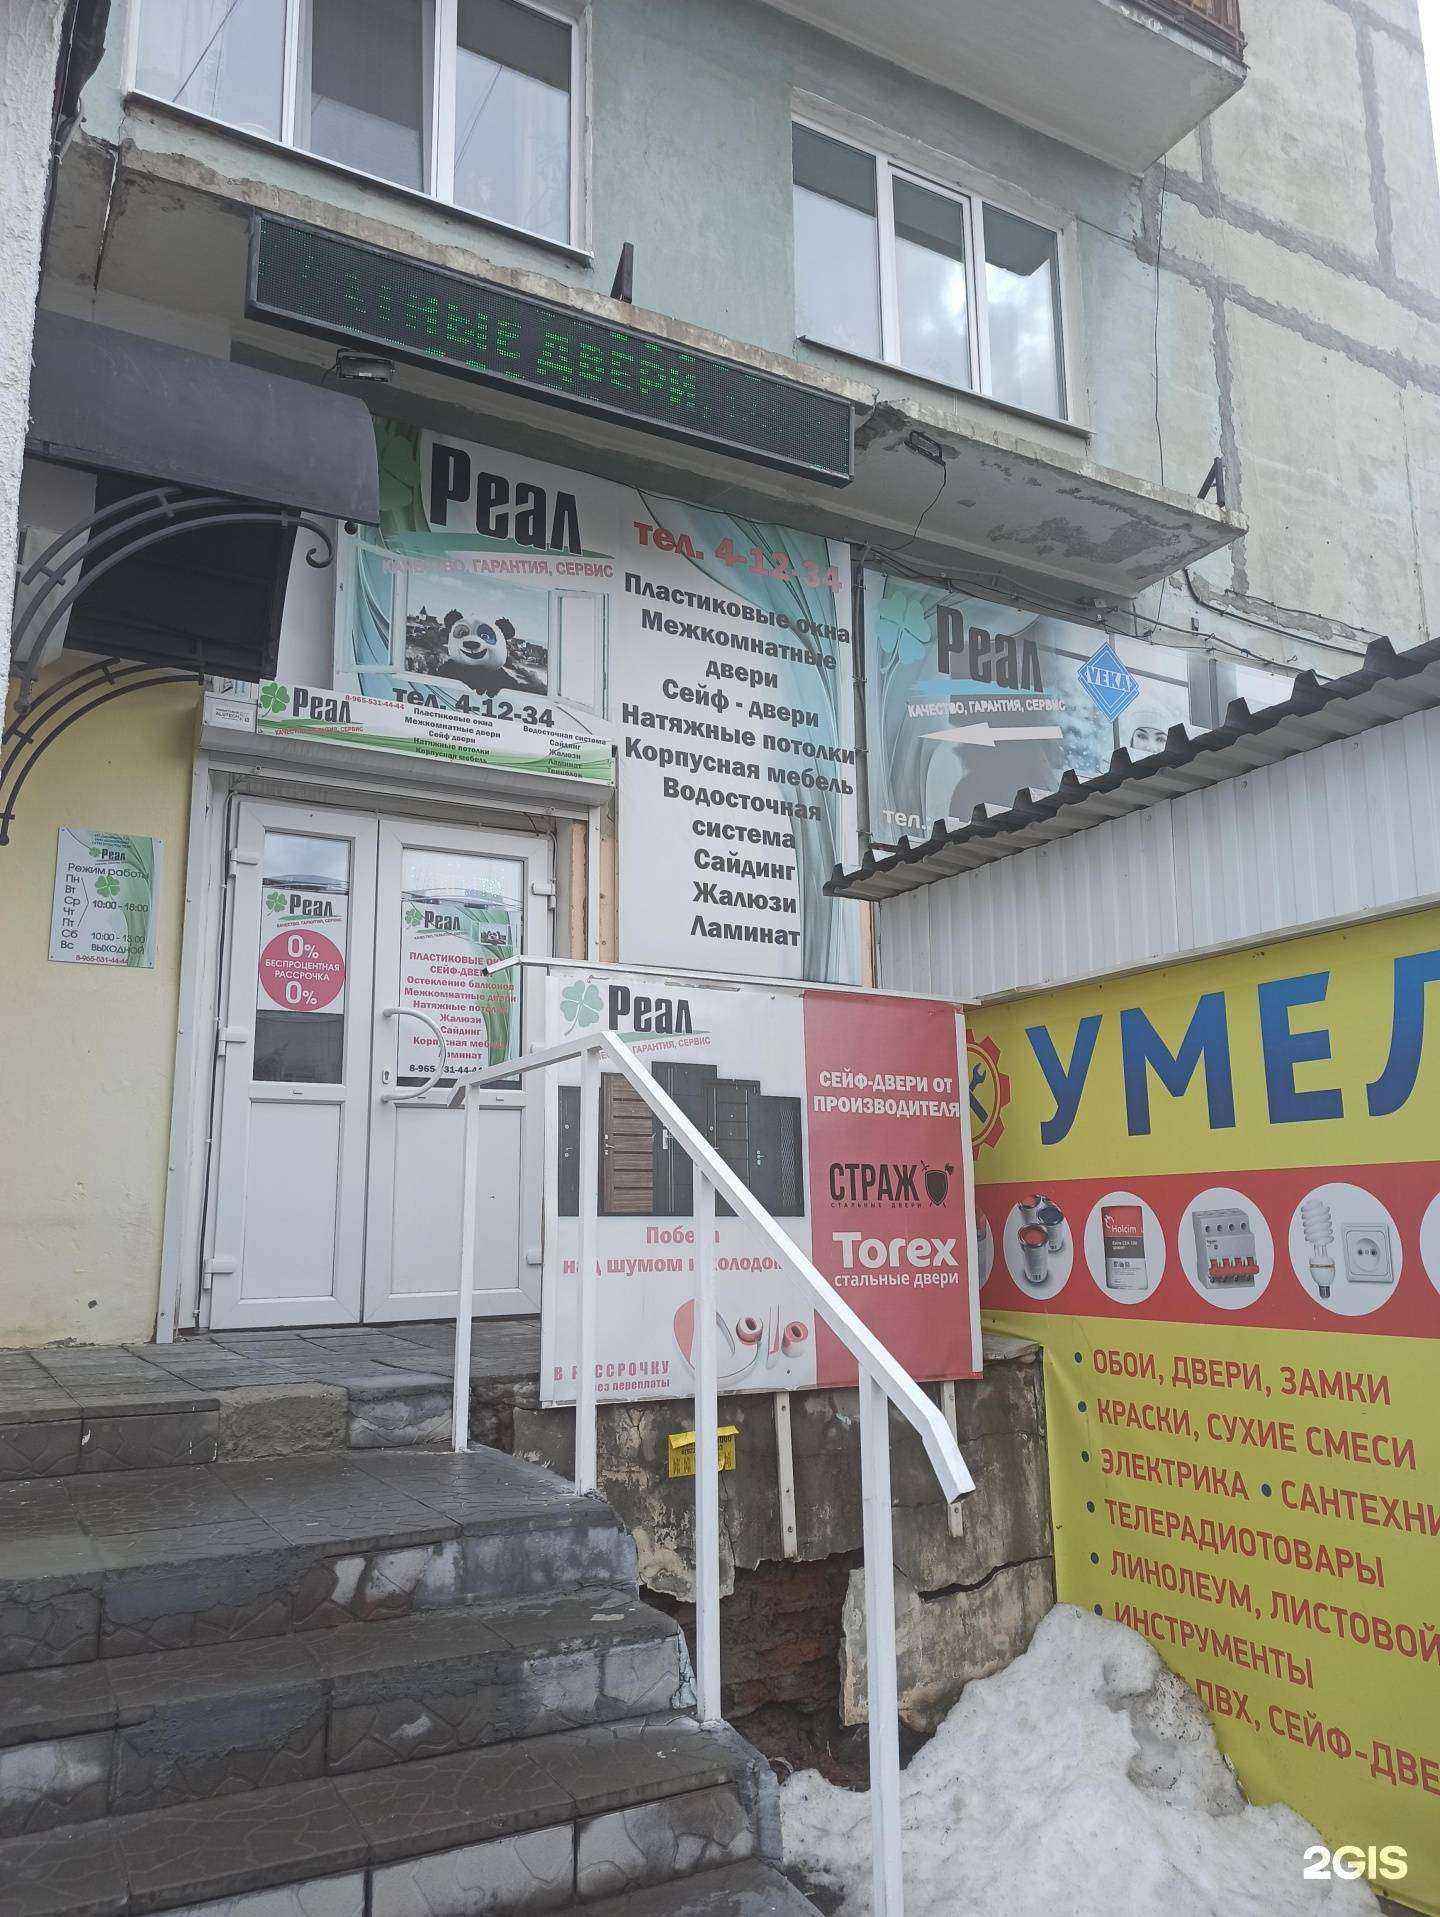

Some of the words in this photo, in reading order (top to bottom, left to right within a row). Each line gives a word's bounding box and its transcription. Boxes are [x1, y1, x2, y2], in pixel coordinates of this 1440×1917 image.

[430, 443, 583, 555] Реал
[634, 521, 703, 560] тел.
[714, 537, 842, 593] 4-12-34
[556, 562, 614, 578] СЕРВИС
[624, 572, 790, 629] Пластиковые
[797, 619, 849, 644] окна
[641, 609, 837, 670] Межкомнатные
[936, 604, 1044, 693] Реал
[705, 661, 778, 689] двери
[1087, 665, 1131, 693] VEKA
[293, 687, 352, 724] Реал
[393, 687, 446, 710] тел.
[455, 694, 555, 728] 4-12-34
[662, 679, 730, 713] Сейф
[749, 699, 819, 728] двери
[969, 700, 1024, 713] ГАРАНТИЯ,
[1025, 699, 1066, 712] СЕРВИС
[413, 707, 471, 724] Пластиковые
[473, 718, 493, 727] окна
[404, 717, 474, 734] Межкомнатные
[475, 728, 501, 739] двери
[523, 725, 573, 740] Водосточная
[622, 703, 756, 747] Натяжные
[763, 733, 855, 765] потолки
[625, 737, 760, 780] Корпусная
[768, 768, 854, 795] мебель
[663, 777, 822, 822] Водосточная
[882, 810, 927, 830] тел.
[692, 819, 795, 849] система
[101, 848, 126, 861] Реал
[693, 848, 795, 881] Сайдинг
[65, 874, 80, 884] Пн
[68, 862, 106, 876] Режим
[108, 868, 149, 880] работы
[65, 885, 76, 894] Вт
[693, 881, 797, 914] Жалюзи
[63, 907, 75, 916] Чт
[64, 896, 80, 907] Ср
[92, 900, 117, 910] 10:00
[289, 894, 333, 917] Реал
[62, 918, 75, 927] Пт
[424, 910, 461, 930] Реал
[61, 929, 78, 939] Сб
[91, 931, 115, 941] 10:00
[690, 915, 801, 947] Ламинат
[60, 940, 74, 950] Вс
[265, 959, 340, 972] БЕСПРОЦЕНТНАЯ
[409, 951, 485, 965] ПЛАСТИКОВЫЕ
[274, 970, 330, 981] РАССРОЧКА
[430, 964, 493, 978] СЕЙФ-ДВЕ
[404, 987, 485, 1001] Межкомнатные
[406, 976, 466, 988] Остекление
[468, 980, 514, 991] балконов
[413, 1000, 466, 1011] Натяжные
[608, 984, 693, 1034] Реал
[440, 1014, 482, 1024] Жалюзи
[441, 1025, 482, 1036] Сайдинг
[632, 1040, 676, 1054] ГАРАНТИЯ,
[678, 1037, 711, 1048] СЕРВИС
[819, 1066, 928, 1093] СЕЙФ-ДВЕРИ
[933, 1077, 953, 1094] ОТ
[813, 1095, 961, 1118] ПРОИЗВОДИТЕЛЯ
[829, 1162, 920, 1201] СТРАЖ
[646, 1226, 720, 1244] Побе
[832, 1231, 960, 1269] Torex
[607, 1257, 683, 1277] шумом
[834, 1273, 910, 1287] стальные
[913, 1272, 959, 1289] двери
[553, 1366, 563, 1381] В
[1092, 1349, 1165, 1386] ОБОИ,
[1172, 1356, 1272, 1398] ДВЕРИ,
[1280, 1366, 1391, 1405] ЗАМКИ
[612, 1378, 670, 1392] переплаты
[1097, 1398, 1200, 1442] КРАСКИ,
[1206, 1413, 1297, 1452] СУХИЕ
[1305, 1426, 1416, 1470] СМЕСИ
[1100, 1448, 1250, 1501] ЭЛЕКТРИКА
[1104, 1499, 1385, 1588] ТЕЛЕРАДИОТОВАРЫ
[1110, 1550, 1262, 1620] ЛИНОЛЕУМ,
[1270, 1590, 1440, 1666] ЛИСТОВОЙ
[1113, 1602, 1314, 1689] ИНСТРУМЕНТЫ
[1195, 1679, 1261, 1732] ПВХ,
